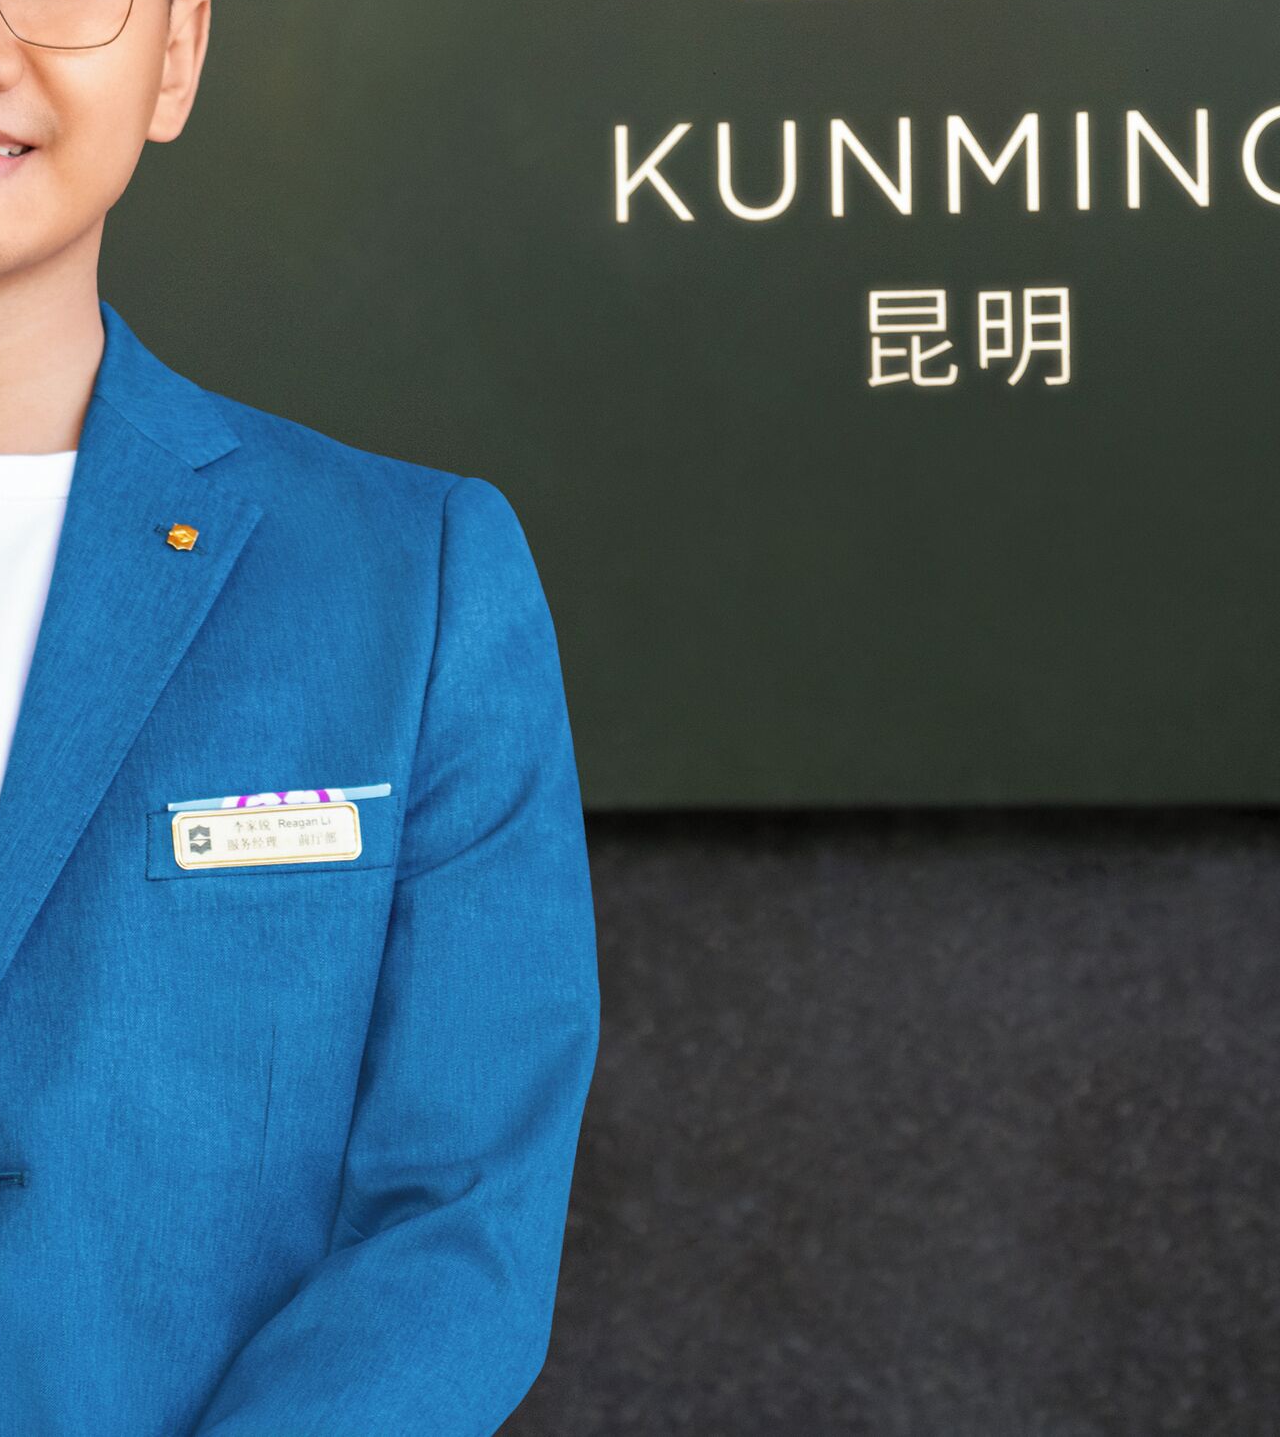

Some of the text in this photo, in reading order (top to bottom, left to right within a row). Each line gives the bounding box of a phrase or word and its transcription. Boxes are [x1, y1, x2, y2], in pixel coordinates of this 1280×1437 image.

[867, 286, 1072, 388] 昆明
[277, 818, 319, 829] Reagan
[320, 816, 332, 826] Li
